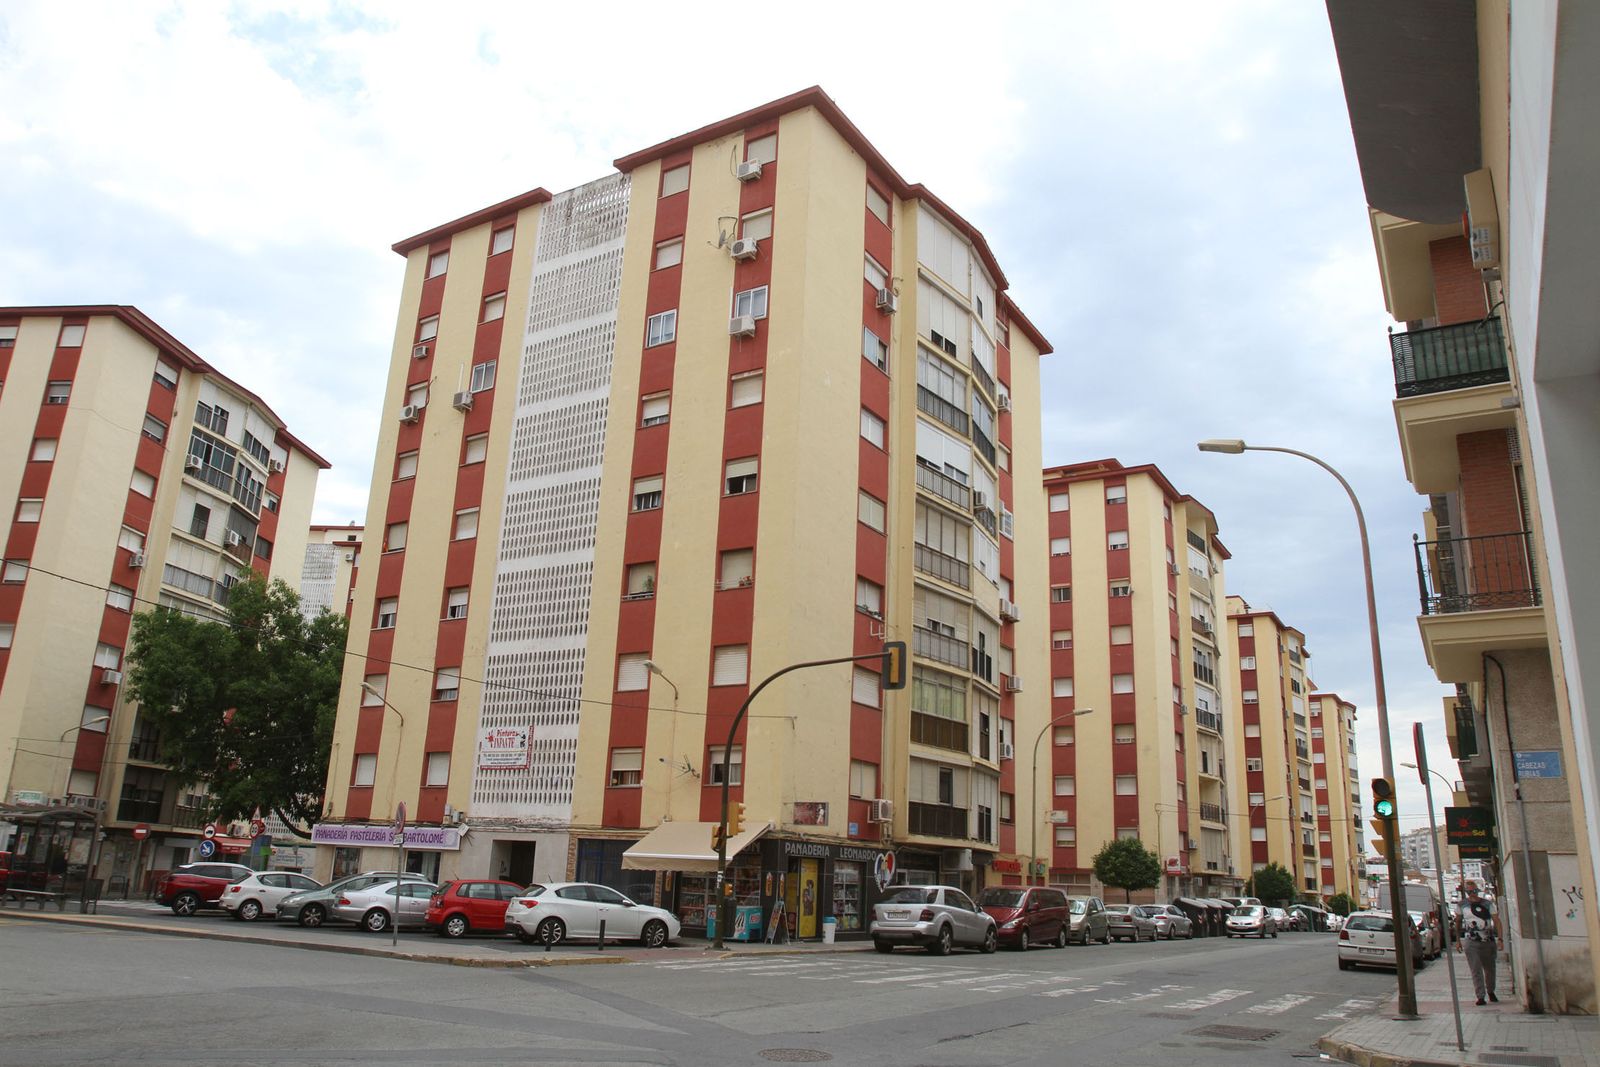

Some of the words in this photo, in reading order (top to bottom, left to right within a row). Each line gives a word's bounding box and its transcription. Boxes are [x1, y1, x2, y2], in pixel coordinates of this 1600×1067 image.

[1516, 761, 1546, 769] CABEZAS
[315, 827, 348, 840] PANADERÍA
[350, 828, 386, 842] PASTELERÍA
[784, 842, 830, 857] PANADERIA
[840, 847, 877, 861] LEONARDO
